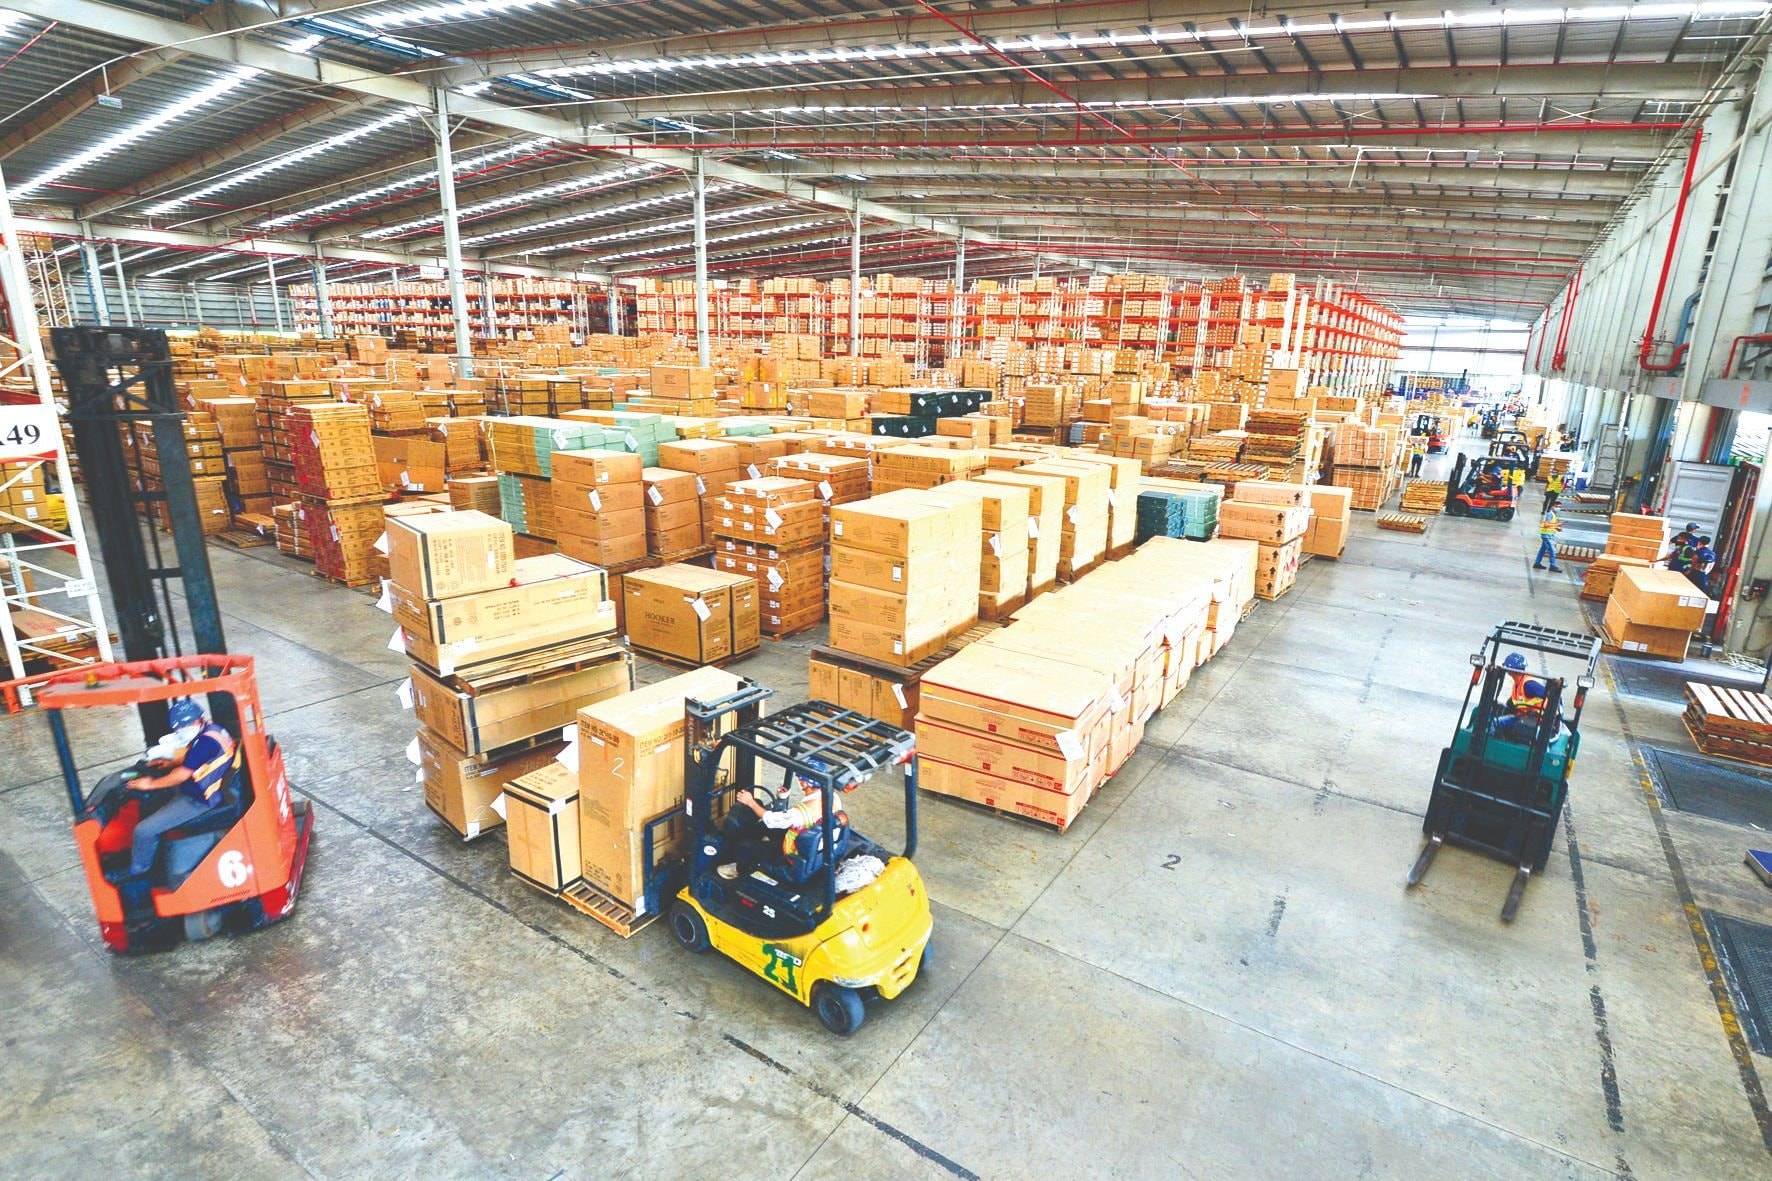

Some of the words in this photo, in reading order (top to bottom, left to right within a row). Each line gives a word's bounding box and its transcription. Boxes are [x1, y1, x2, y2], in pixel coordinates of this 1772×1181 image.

[0, 424, 41, 446] 49
[611, 757, 625, 780] 2
[217, 850, 247, 888] 6
[1160, 854, 1182, 871] 2
[762, 905, 776, 919] 25
[762, 943, 799, 995] 21
